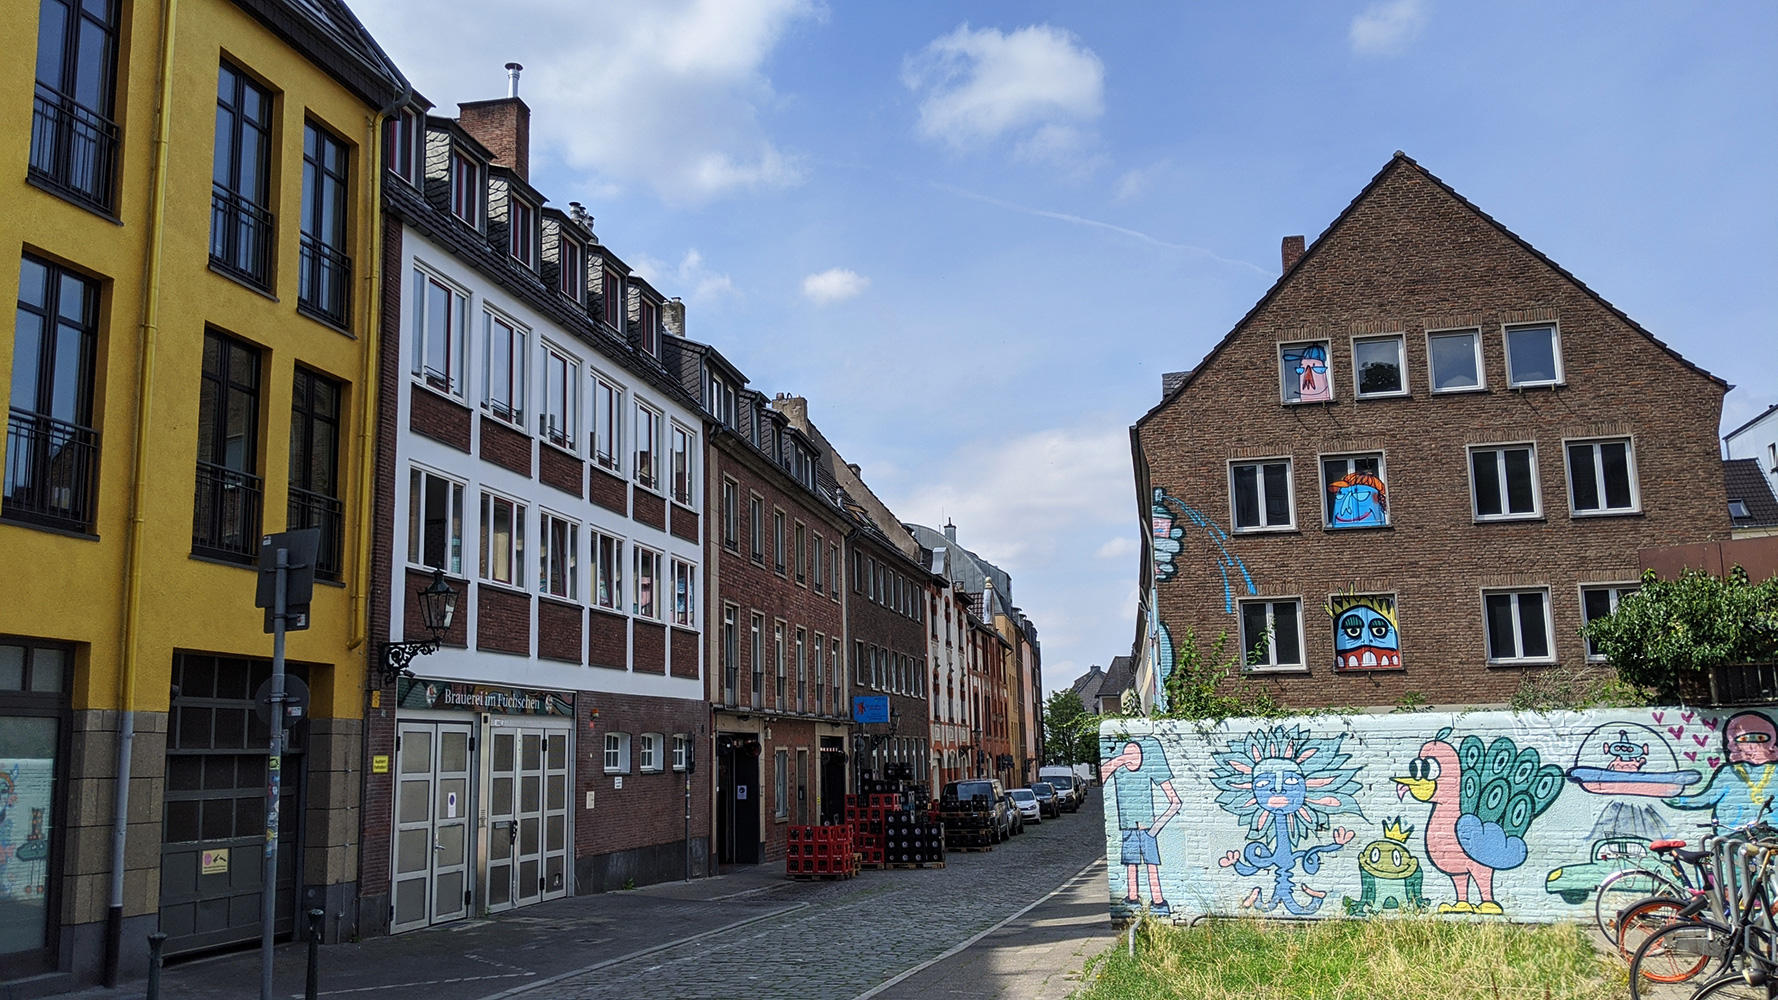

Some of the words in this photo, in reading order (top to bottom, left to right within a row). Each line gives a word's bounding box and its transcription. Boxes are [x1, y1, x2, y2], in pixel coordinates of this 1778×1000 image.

[445, 688, 483, 706] Brauerei
[485, 692, 495, 706] im
[498, 692, 540, 709] Füchschen
